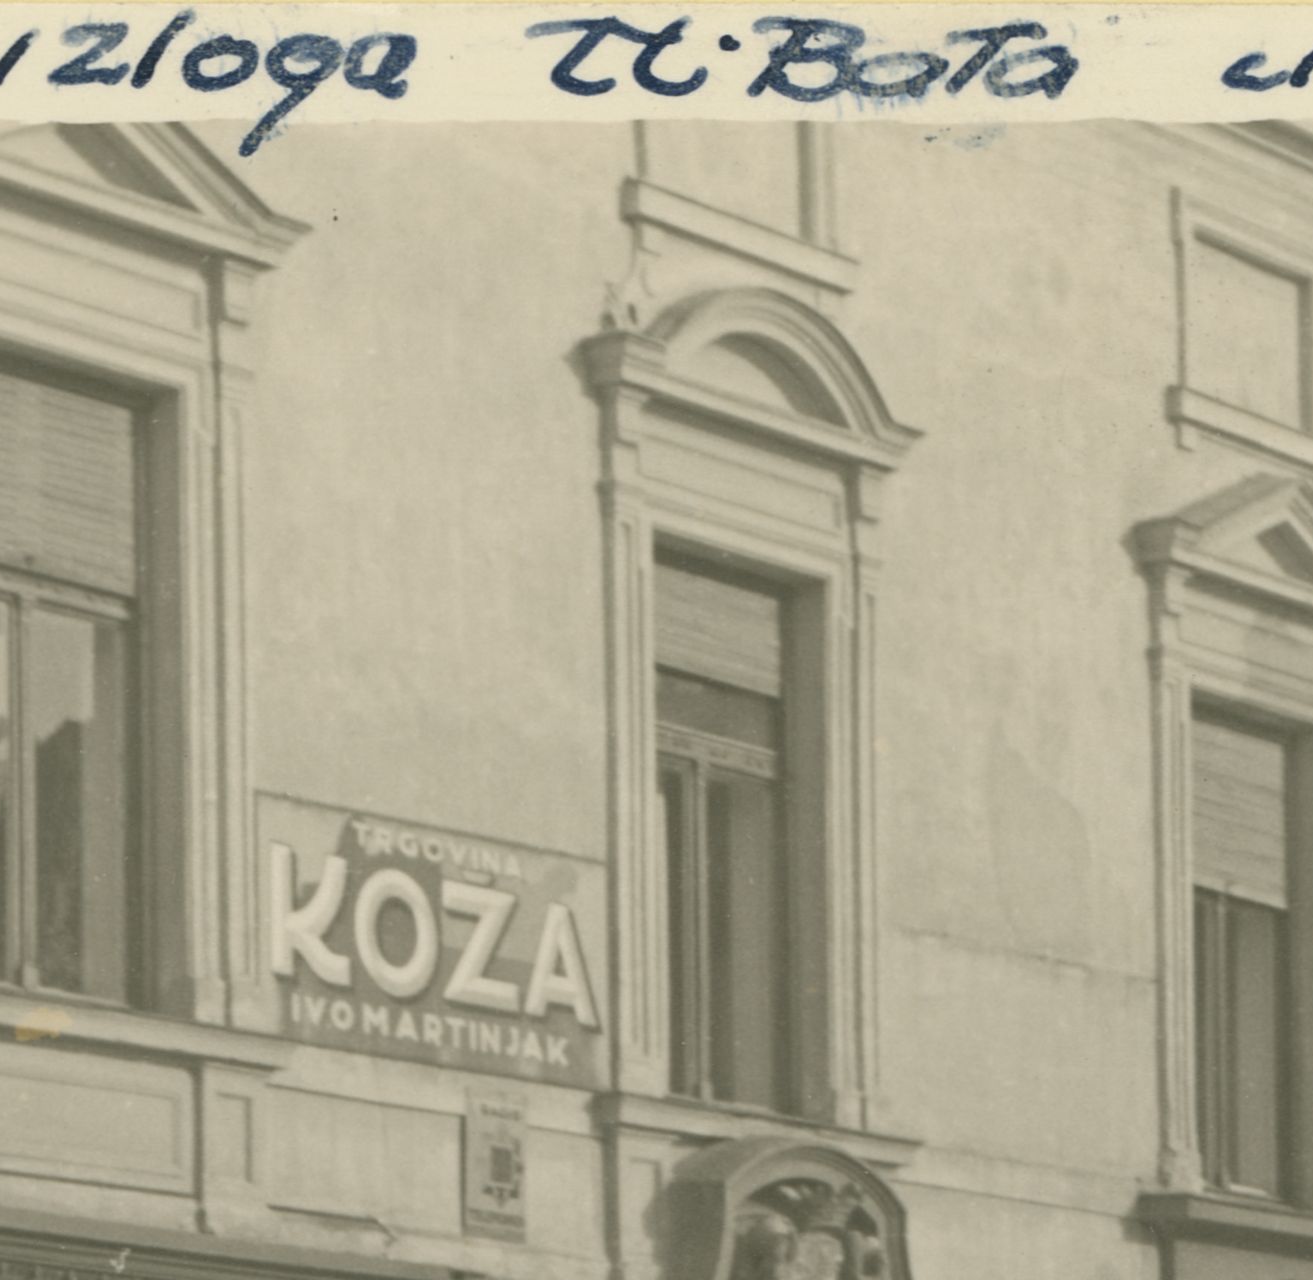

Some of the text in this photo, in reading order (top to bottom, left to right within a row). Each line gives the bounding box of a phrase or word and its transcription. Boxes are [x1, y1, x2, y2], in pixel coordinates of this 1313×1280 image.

[352, 821, 522, 877] TRGOVINA
[270, 840, 599, 1029] KOŽA
[291, 992, 570, 1067] IVO MARTINJAK
